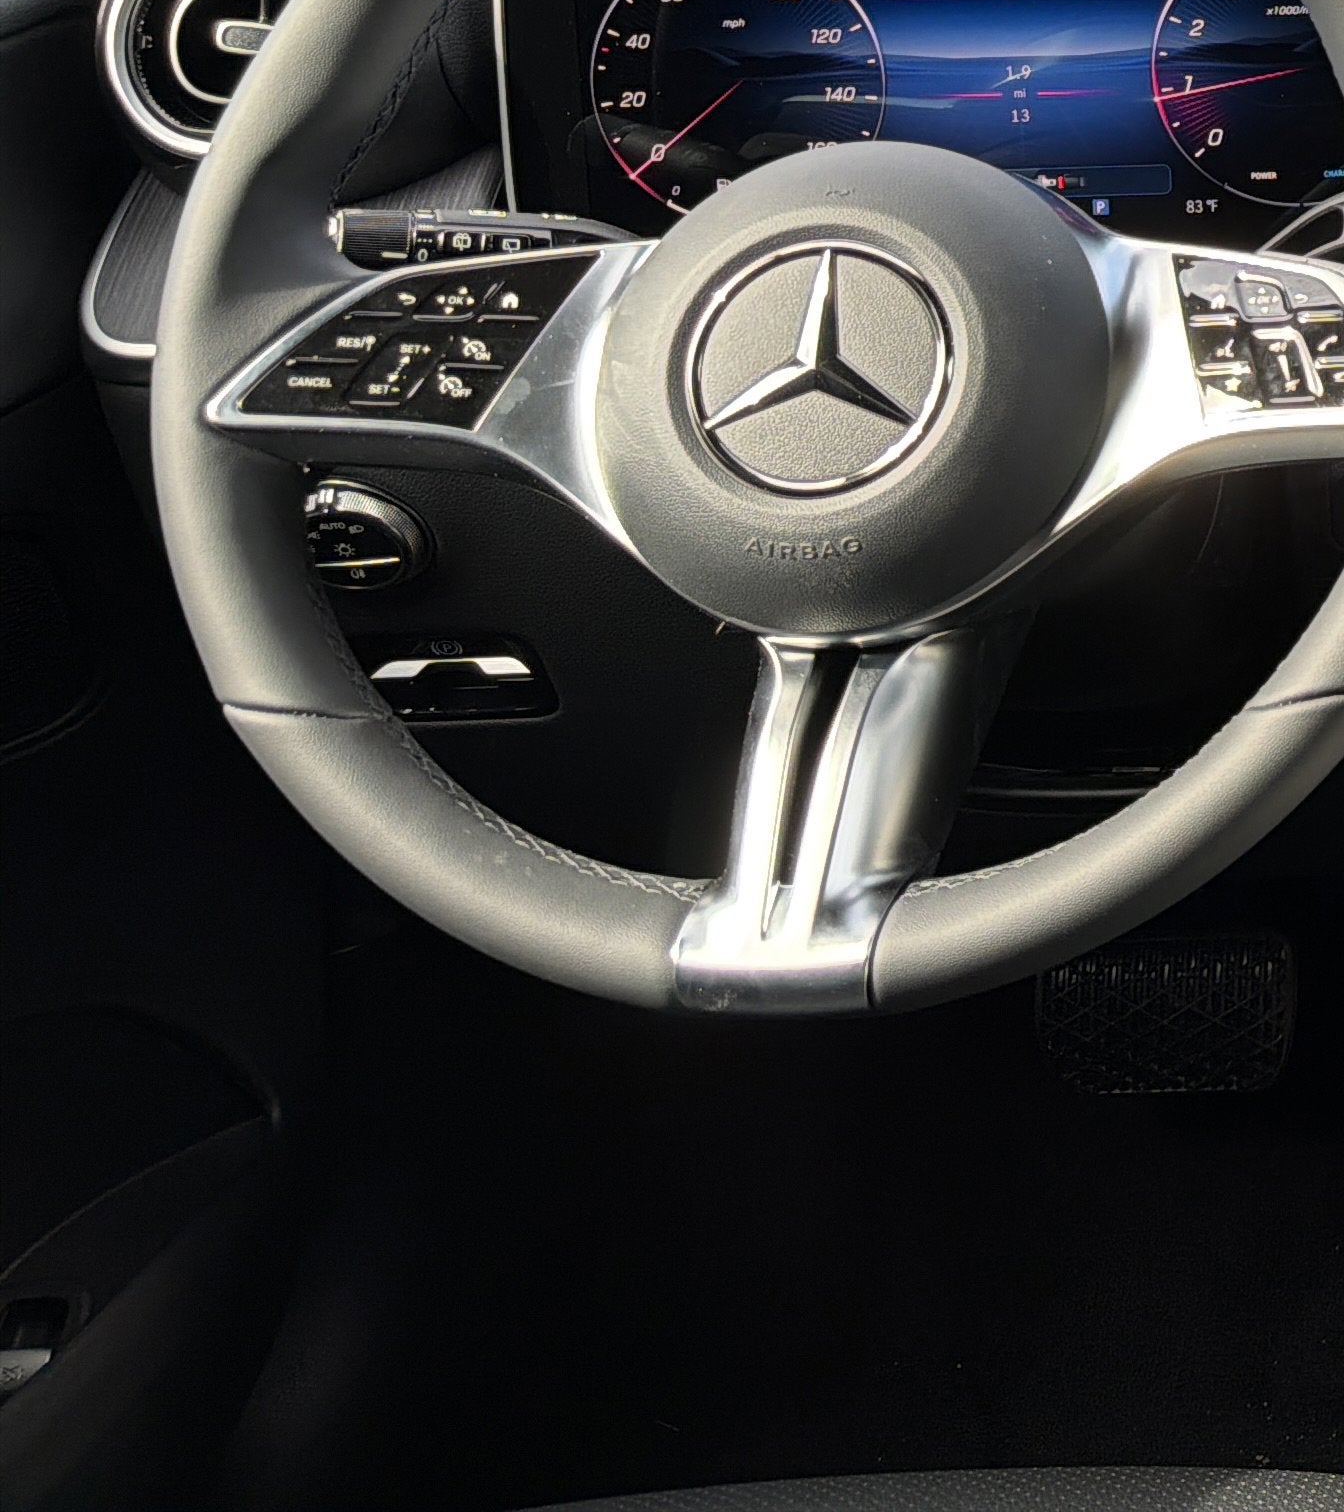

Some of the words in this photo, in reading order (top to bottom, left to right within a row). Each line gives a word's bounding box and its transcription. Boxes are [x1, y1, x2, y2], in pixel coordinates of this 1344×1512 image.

[722, 18, 746, 30] mph
[1188, 19, 1205, 37] 2
[625, 33, 651, 50] 40
[811, 28, 842, 44] 120
[1005, 65, 1032, 80] 1.9
[1184, 75, 1194, 93] 1
[619, 91, 647, 108] 20
[824, 86, 856, 103] 140
[1013, 88, 1027, 98] mi
[1011, 109, 1031, 123] 13
[1207, 128, 1224, 147] 0
[651, 143, 667, 162] 0
[1250, 171, 1278, 180] POWER
[671, 185, 681, 196] 0
[1186, 199, 1204, 214] 83
[448, 295, 464, 305] OK
[400, 344, 421, 354] SET
[475, 351, 491, 361] ON
[287, 375, 332, 388] CANCEL
[368, 383, 390, 395] SET
[451, 387, 473, 398] OFF
[745, 537, 864, 561] AIRBAG
